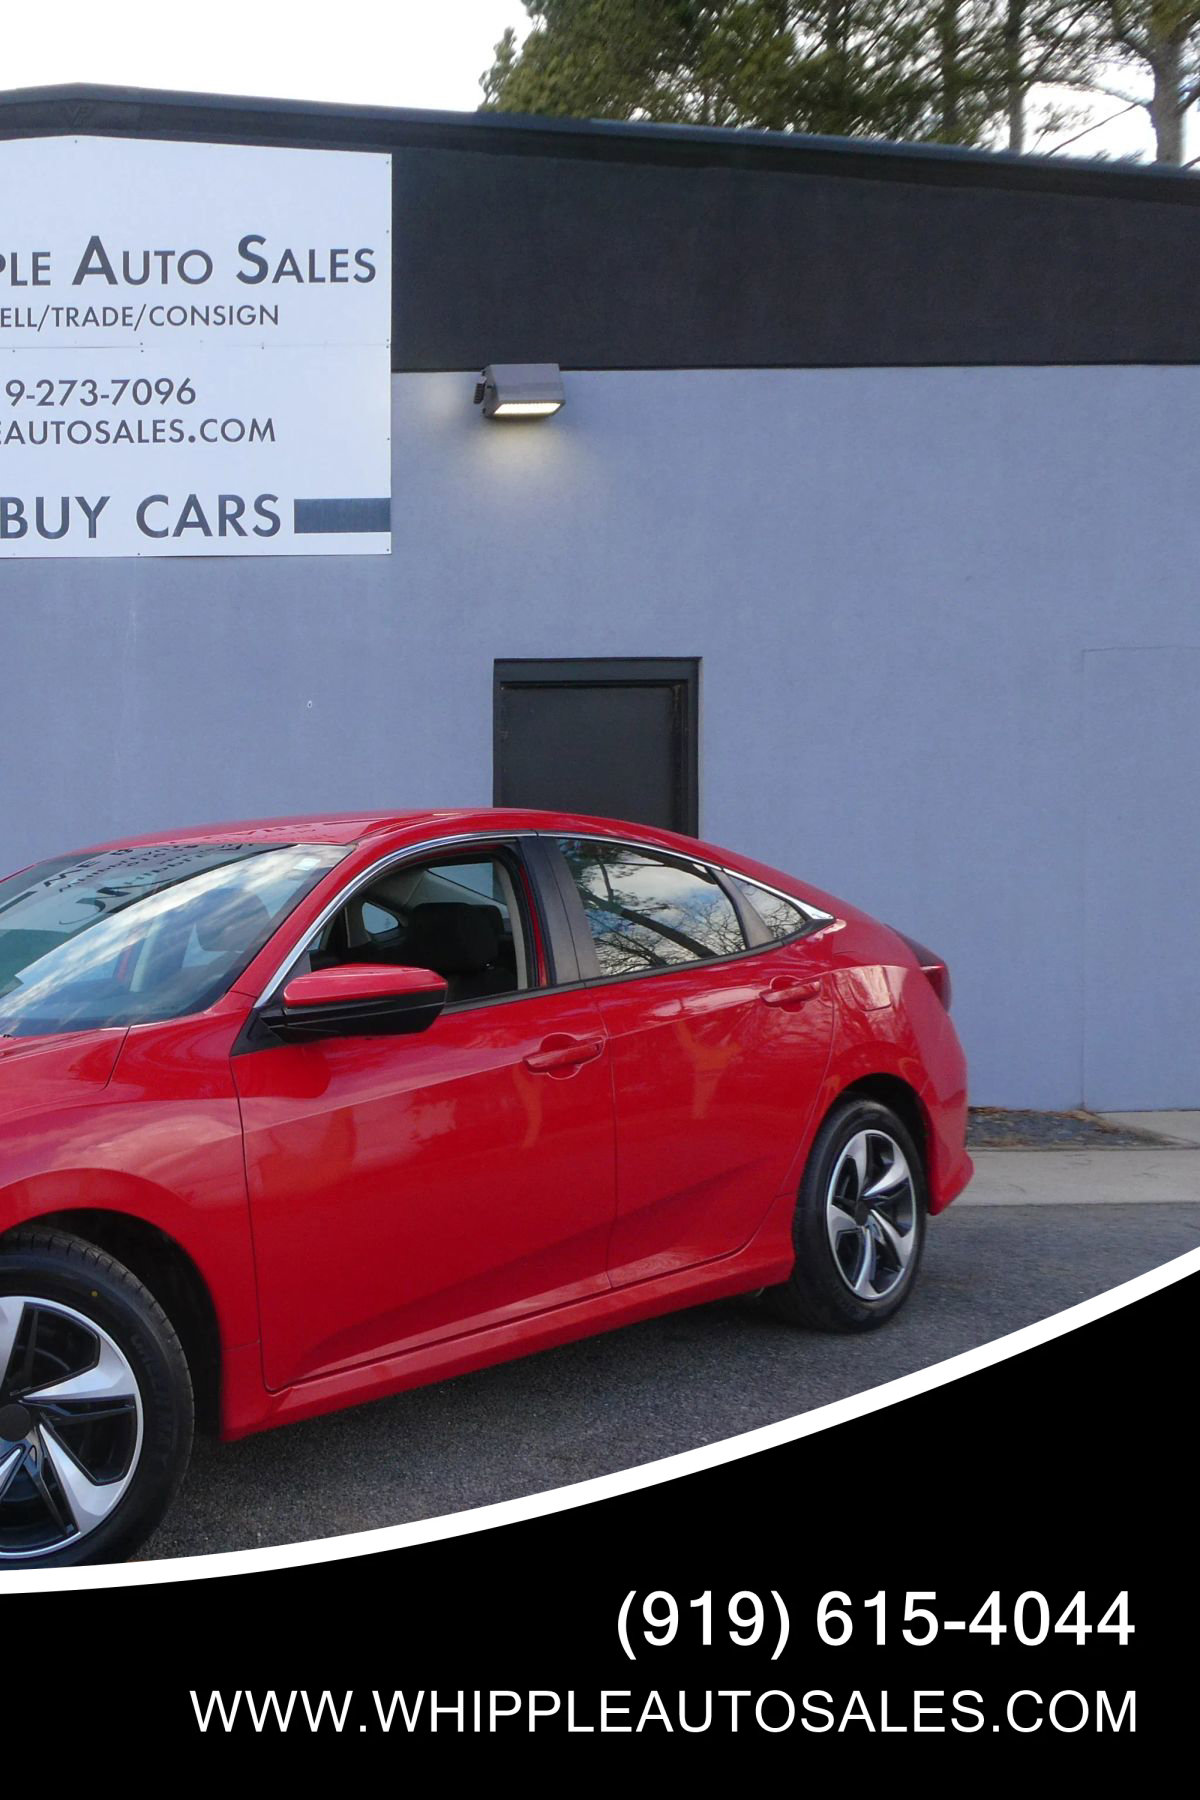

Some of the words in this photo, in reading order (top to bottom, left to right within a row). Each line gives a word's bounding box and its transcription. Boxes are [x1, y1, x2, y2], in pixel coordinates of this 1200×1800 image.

[72, 235, 214, 286] AUTO
[235, 234, 377, 285] SALES
[0, 495, 111, 540] BUY
[135, 493, 282, 539] CARS
